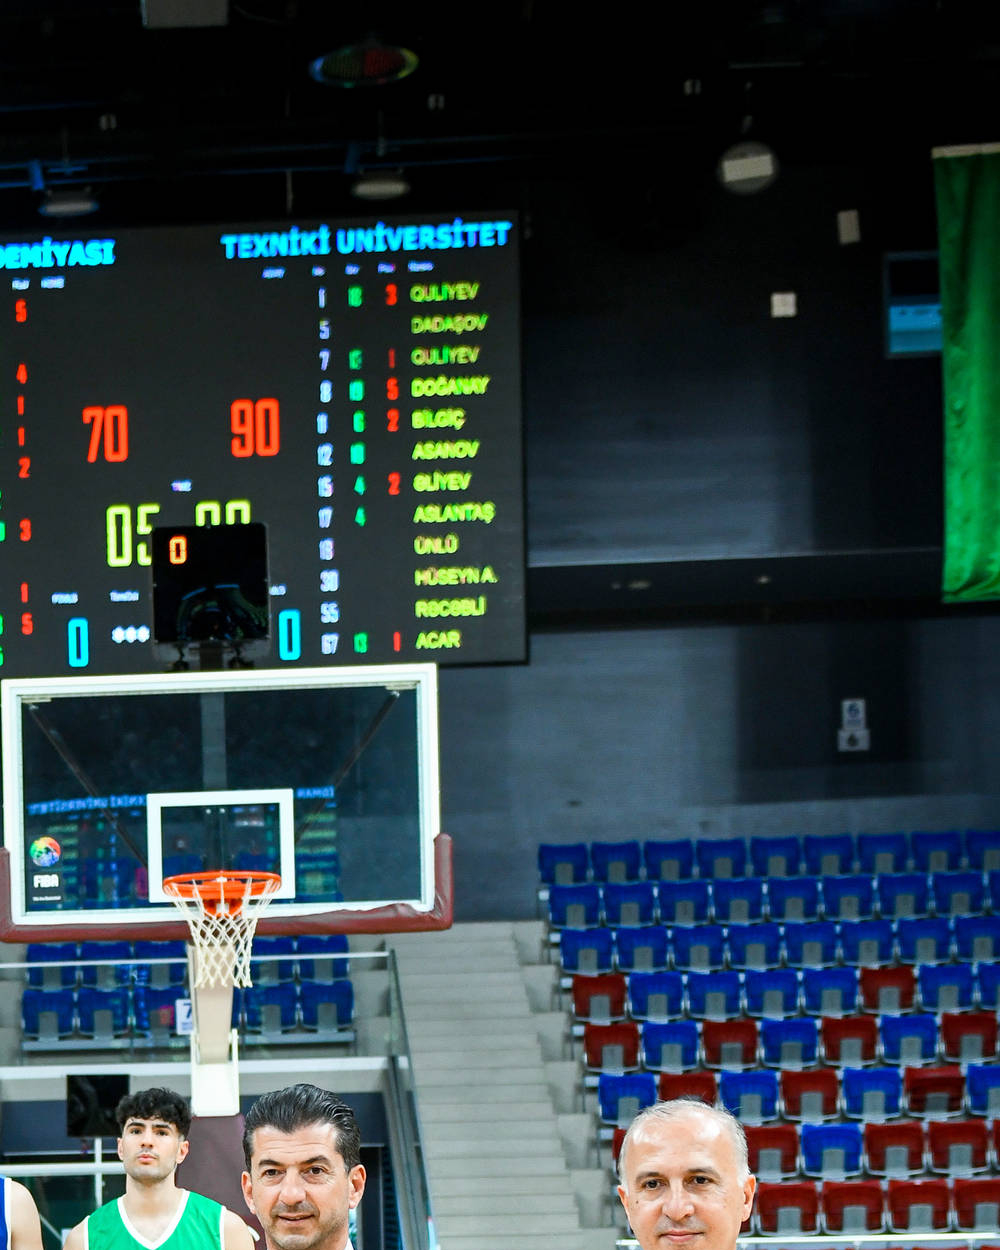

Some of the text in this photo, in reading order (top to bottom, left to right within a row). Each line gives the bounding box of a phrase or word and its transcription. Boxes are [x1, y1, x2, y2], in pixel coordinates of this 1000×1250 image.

[220, 217, 513, 259] TEXNİKİ UNİVERSİTET
[15, 298, 28, 322] 5
[320, 319, 330, 340] 5
[319, 348, 331, 371] 7
[388, 349, 396, 369] 1
[16, 363, 28, 385] 4
[17, 395, 25, 416] 1
[231, 398, 281, 457] 90
[387, 408, 400, 432] 2
[18, 426, 26, 447] 1
[81, 405, 129, 463] 70
[18, 456, 31, 478] 2
[354, 475, 366, 496] 4
[388, 471, 401, 496] 2
[355, 507, 367, 527] 4
[19, 518, 32, 542] 3
[20, 582, 29, 604] 1
[21, 612, 34, 636] 5
[278, 608, 300, 661] 0
[68, 616, 89, 668] 0
[393, 632, 402, 653] 1
